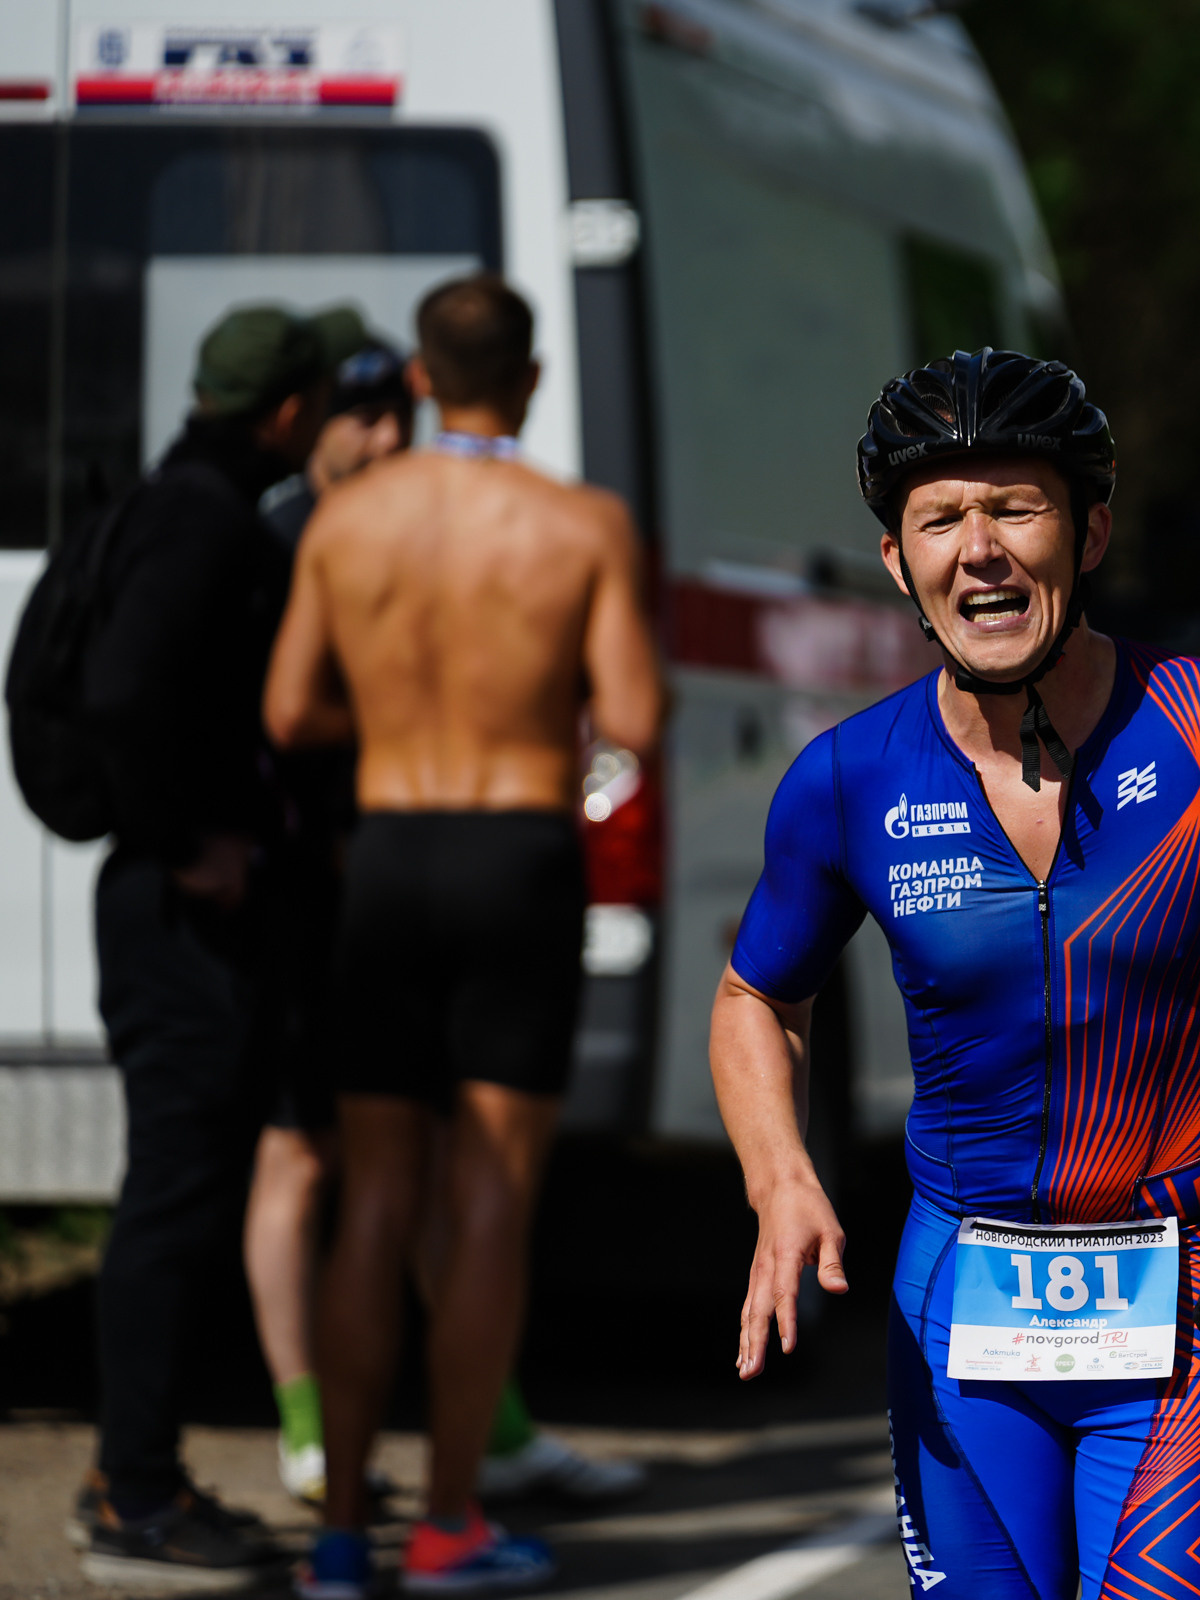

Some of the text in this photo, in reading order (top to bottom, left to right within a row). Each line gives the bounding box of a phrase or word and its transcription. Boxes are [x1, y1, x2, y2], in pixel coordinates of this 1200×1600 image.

[888, 441, 929, 467] uvex
[910, 801, 969, 822] ГАЗПРОМ
[888, 855, 985, 882] КОМАНДА
[890, 872, 983, 901] ГАЗПРОМ
[893, 891, 961, 918] НЕФТИ
[1069, 1235, 1133, 1248] ТРИАТЛОН
[1135, 1233, 1165, 1245] 2023
[1010, 1253, 1129, 1312] 181
[1029, 1314, 1108, 1329] Александр
